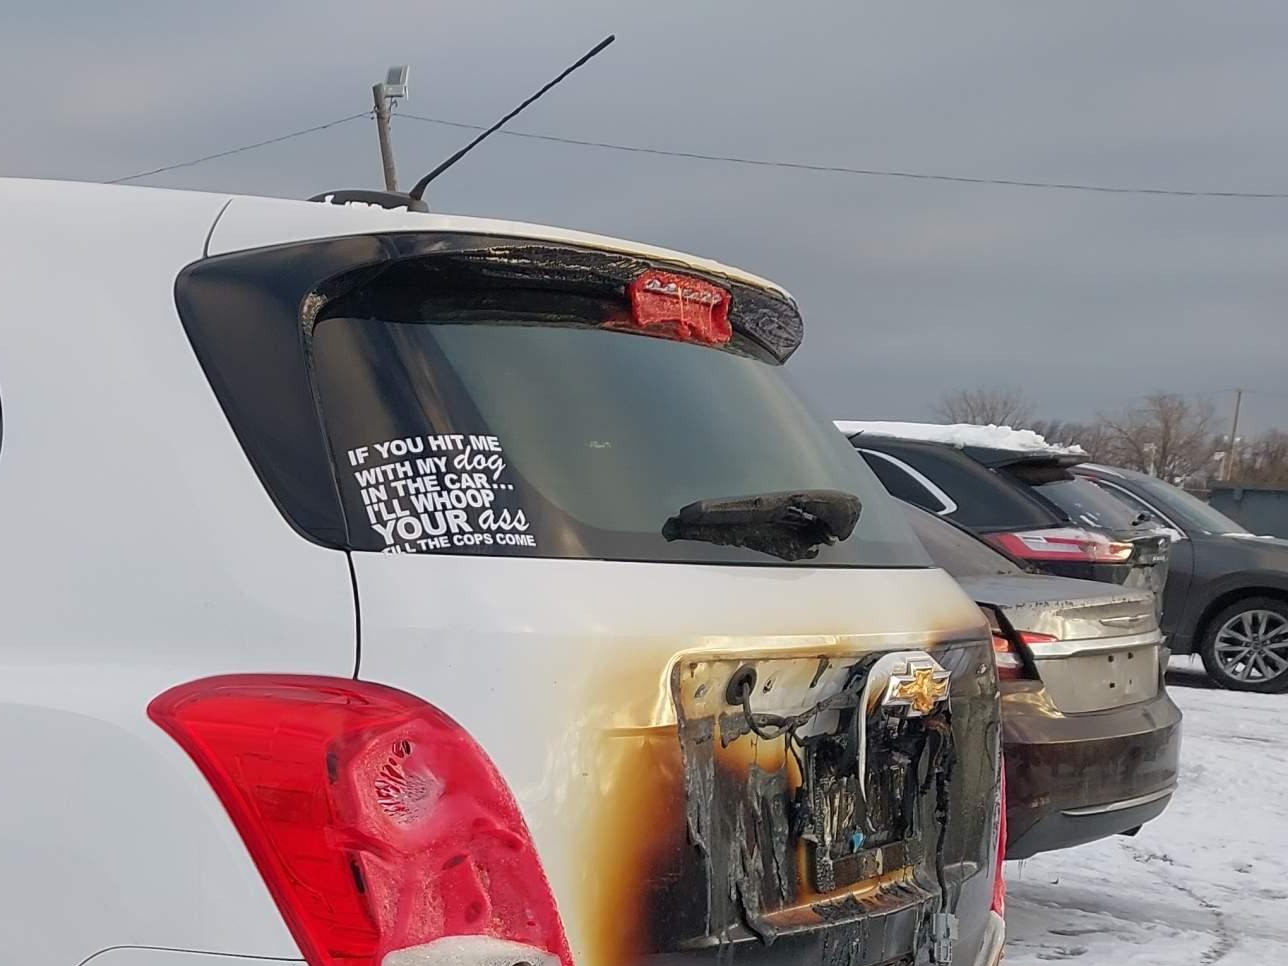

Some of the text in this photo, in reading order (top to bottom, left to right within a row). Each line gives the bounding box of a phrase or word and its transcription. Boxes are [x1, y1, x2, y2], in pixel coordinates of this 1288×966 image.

[348, 434, 503, 466] IF YOU HIT ME
[354, 446, 506, 487] WITH MY dog
[360, 487, 388, 506] IN
[391, 475, 441, 499] THE
[365, 489, 495, 524] I'LL WHOOP
[371, 508, 530, 545] YOUR ass
[417, 535, 451, 550] THE
[453, 534, 491, 547] COPS
[495, 533, 537, 547] COME
